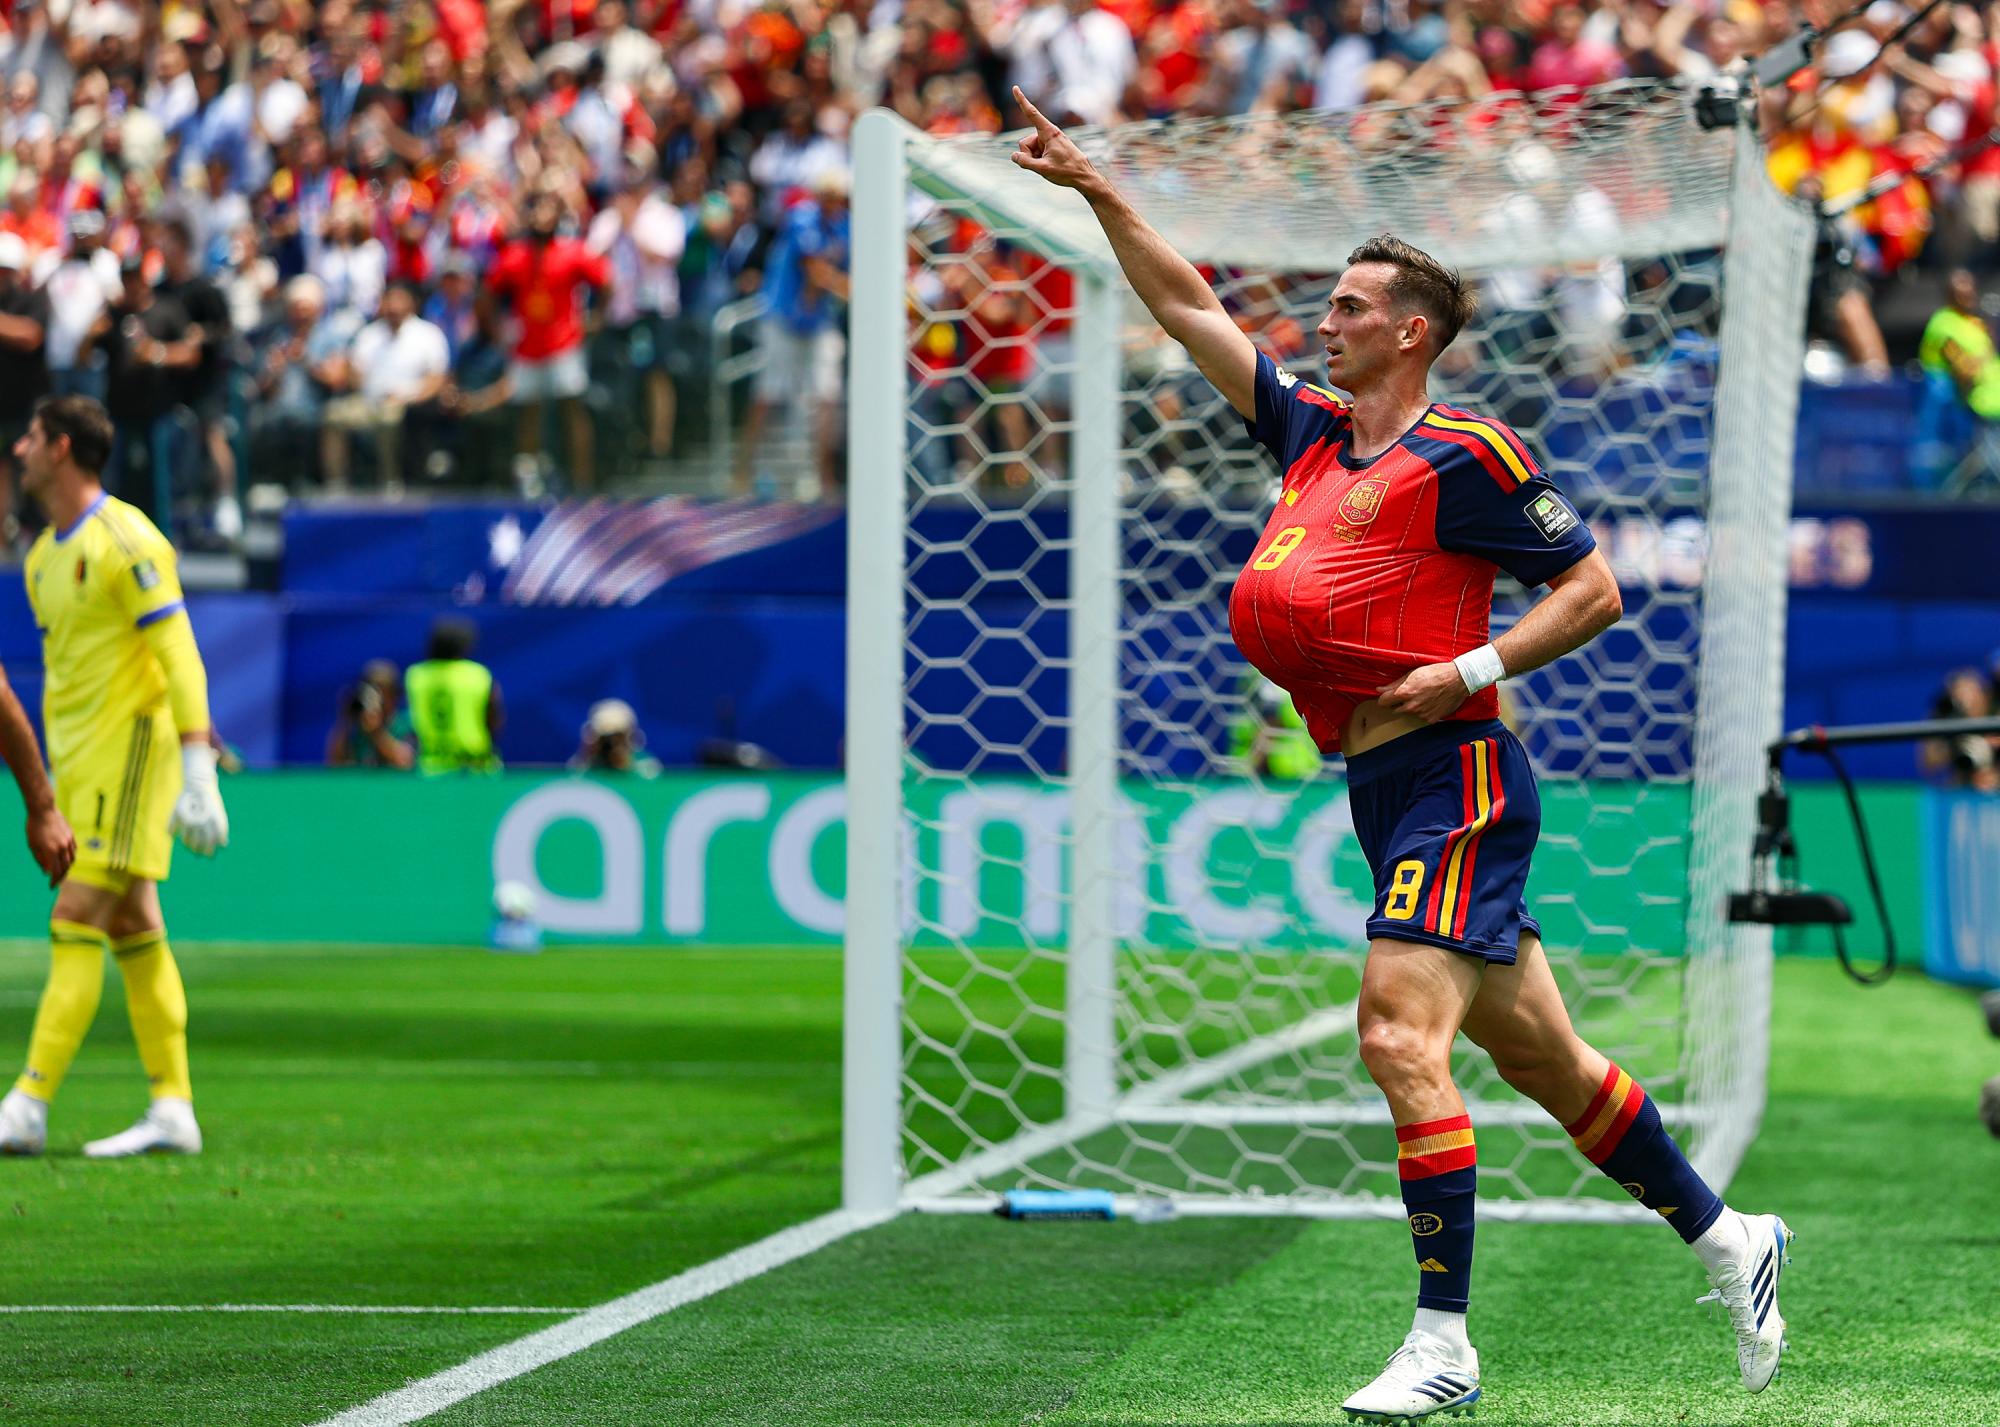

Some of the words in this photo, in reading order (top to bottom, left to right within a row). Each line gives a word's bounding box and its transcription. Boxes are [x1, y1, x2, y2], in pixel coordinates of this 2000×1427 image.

[1545, 512, 1569, 533] EDUCATION
[1252, 526, 1307, 571] 8
[95, 792, 105, 831] 1
[1384, 860, 1426, 920] 8
